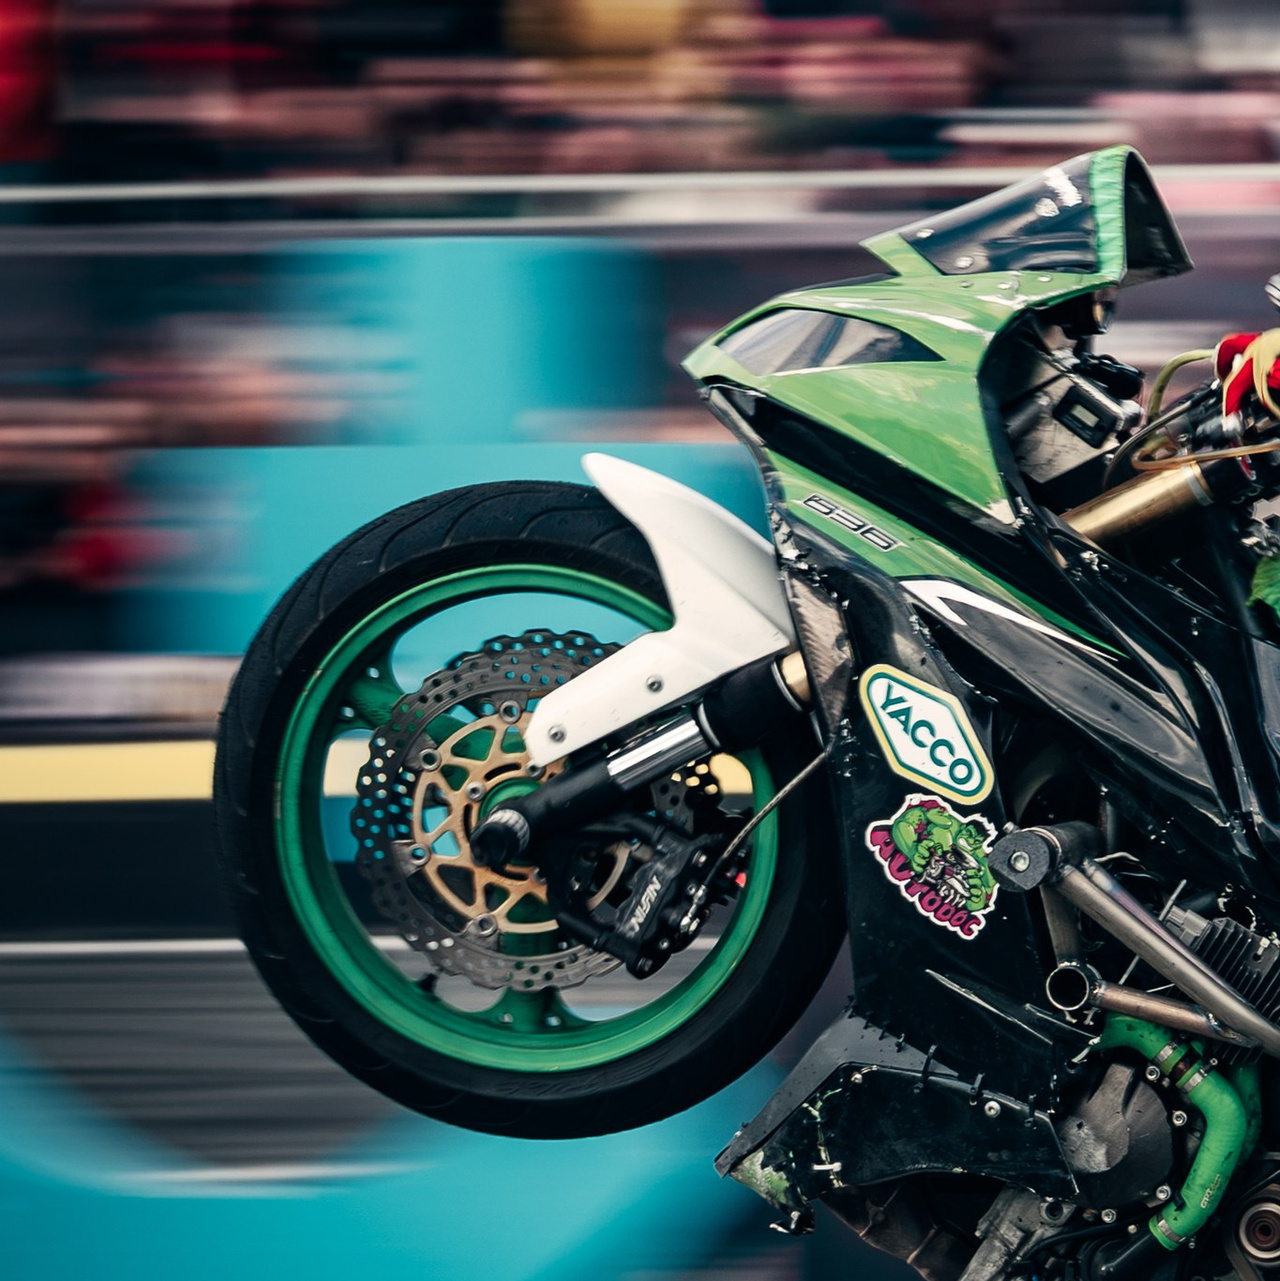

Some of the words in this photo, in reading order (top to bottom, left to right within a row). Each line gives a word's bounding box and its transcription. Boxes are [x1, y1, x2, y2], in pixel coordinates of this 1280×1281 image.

[801, 493, 899, 552] 636
[880, 681, 974, 786] YACCO
[869, 824, 983, 938] AUTODOC
